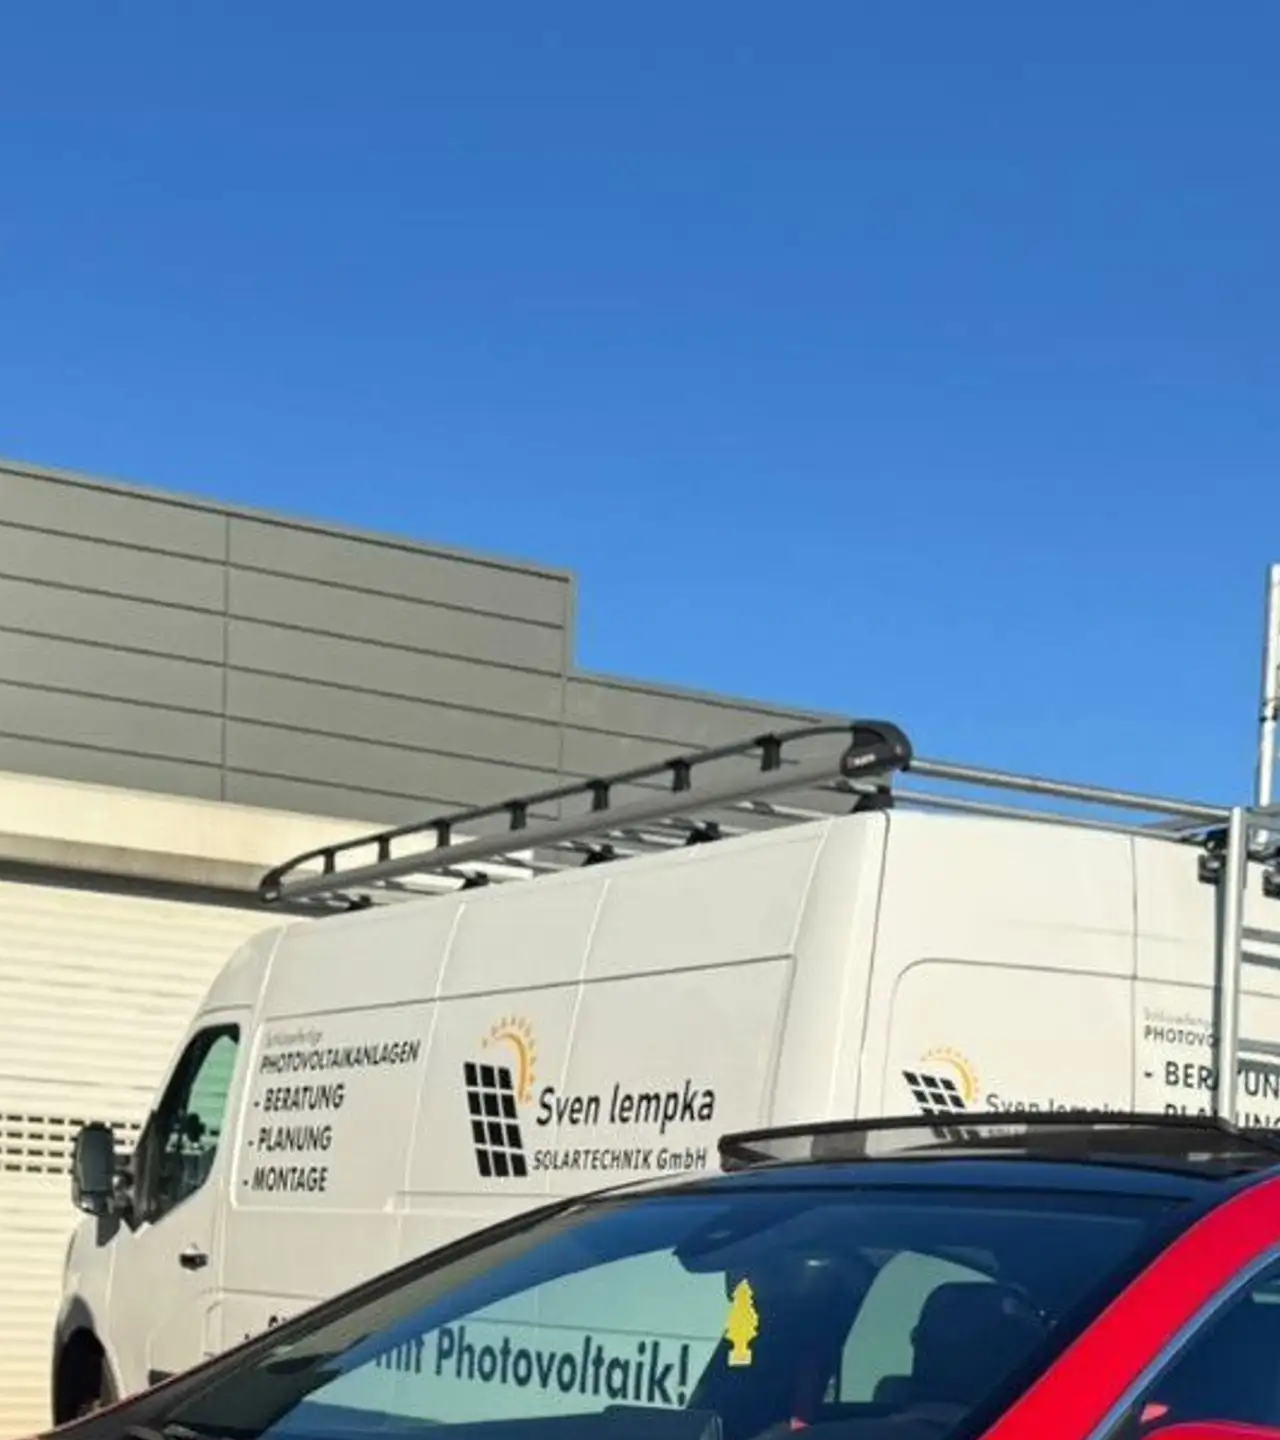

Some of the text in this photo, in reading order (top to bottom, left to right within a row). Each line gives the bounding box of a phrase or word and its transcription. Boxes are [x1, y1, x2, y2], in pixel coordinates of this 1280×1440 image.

[258, 1038, 422, 1075] PHOTOVOLTAIKANLAGEN
[263, 1082, 346, 1113] BERATUNG
[536, 1079, 716, 1135] Sven lempka
[256, 1124, 333, 1152] PLANUNG
[533, 1148, 708, 1172] SOLARTECHNIK GmbH
[251, 1165, 329, 1193] MONTAGE
[435, 1324, 690, 1407] Photovoltaik!
